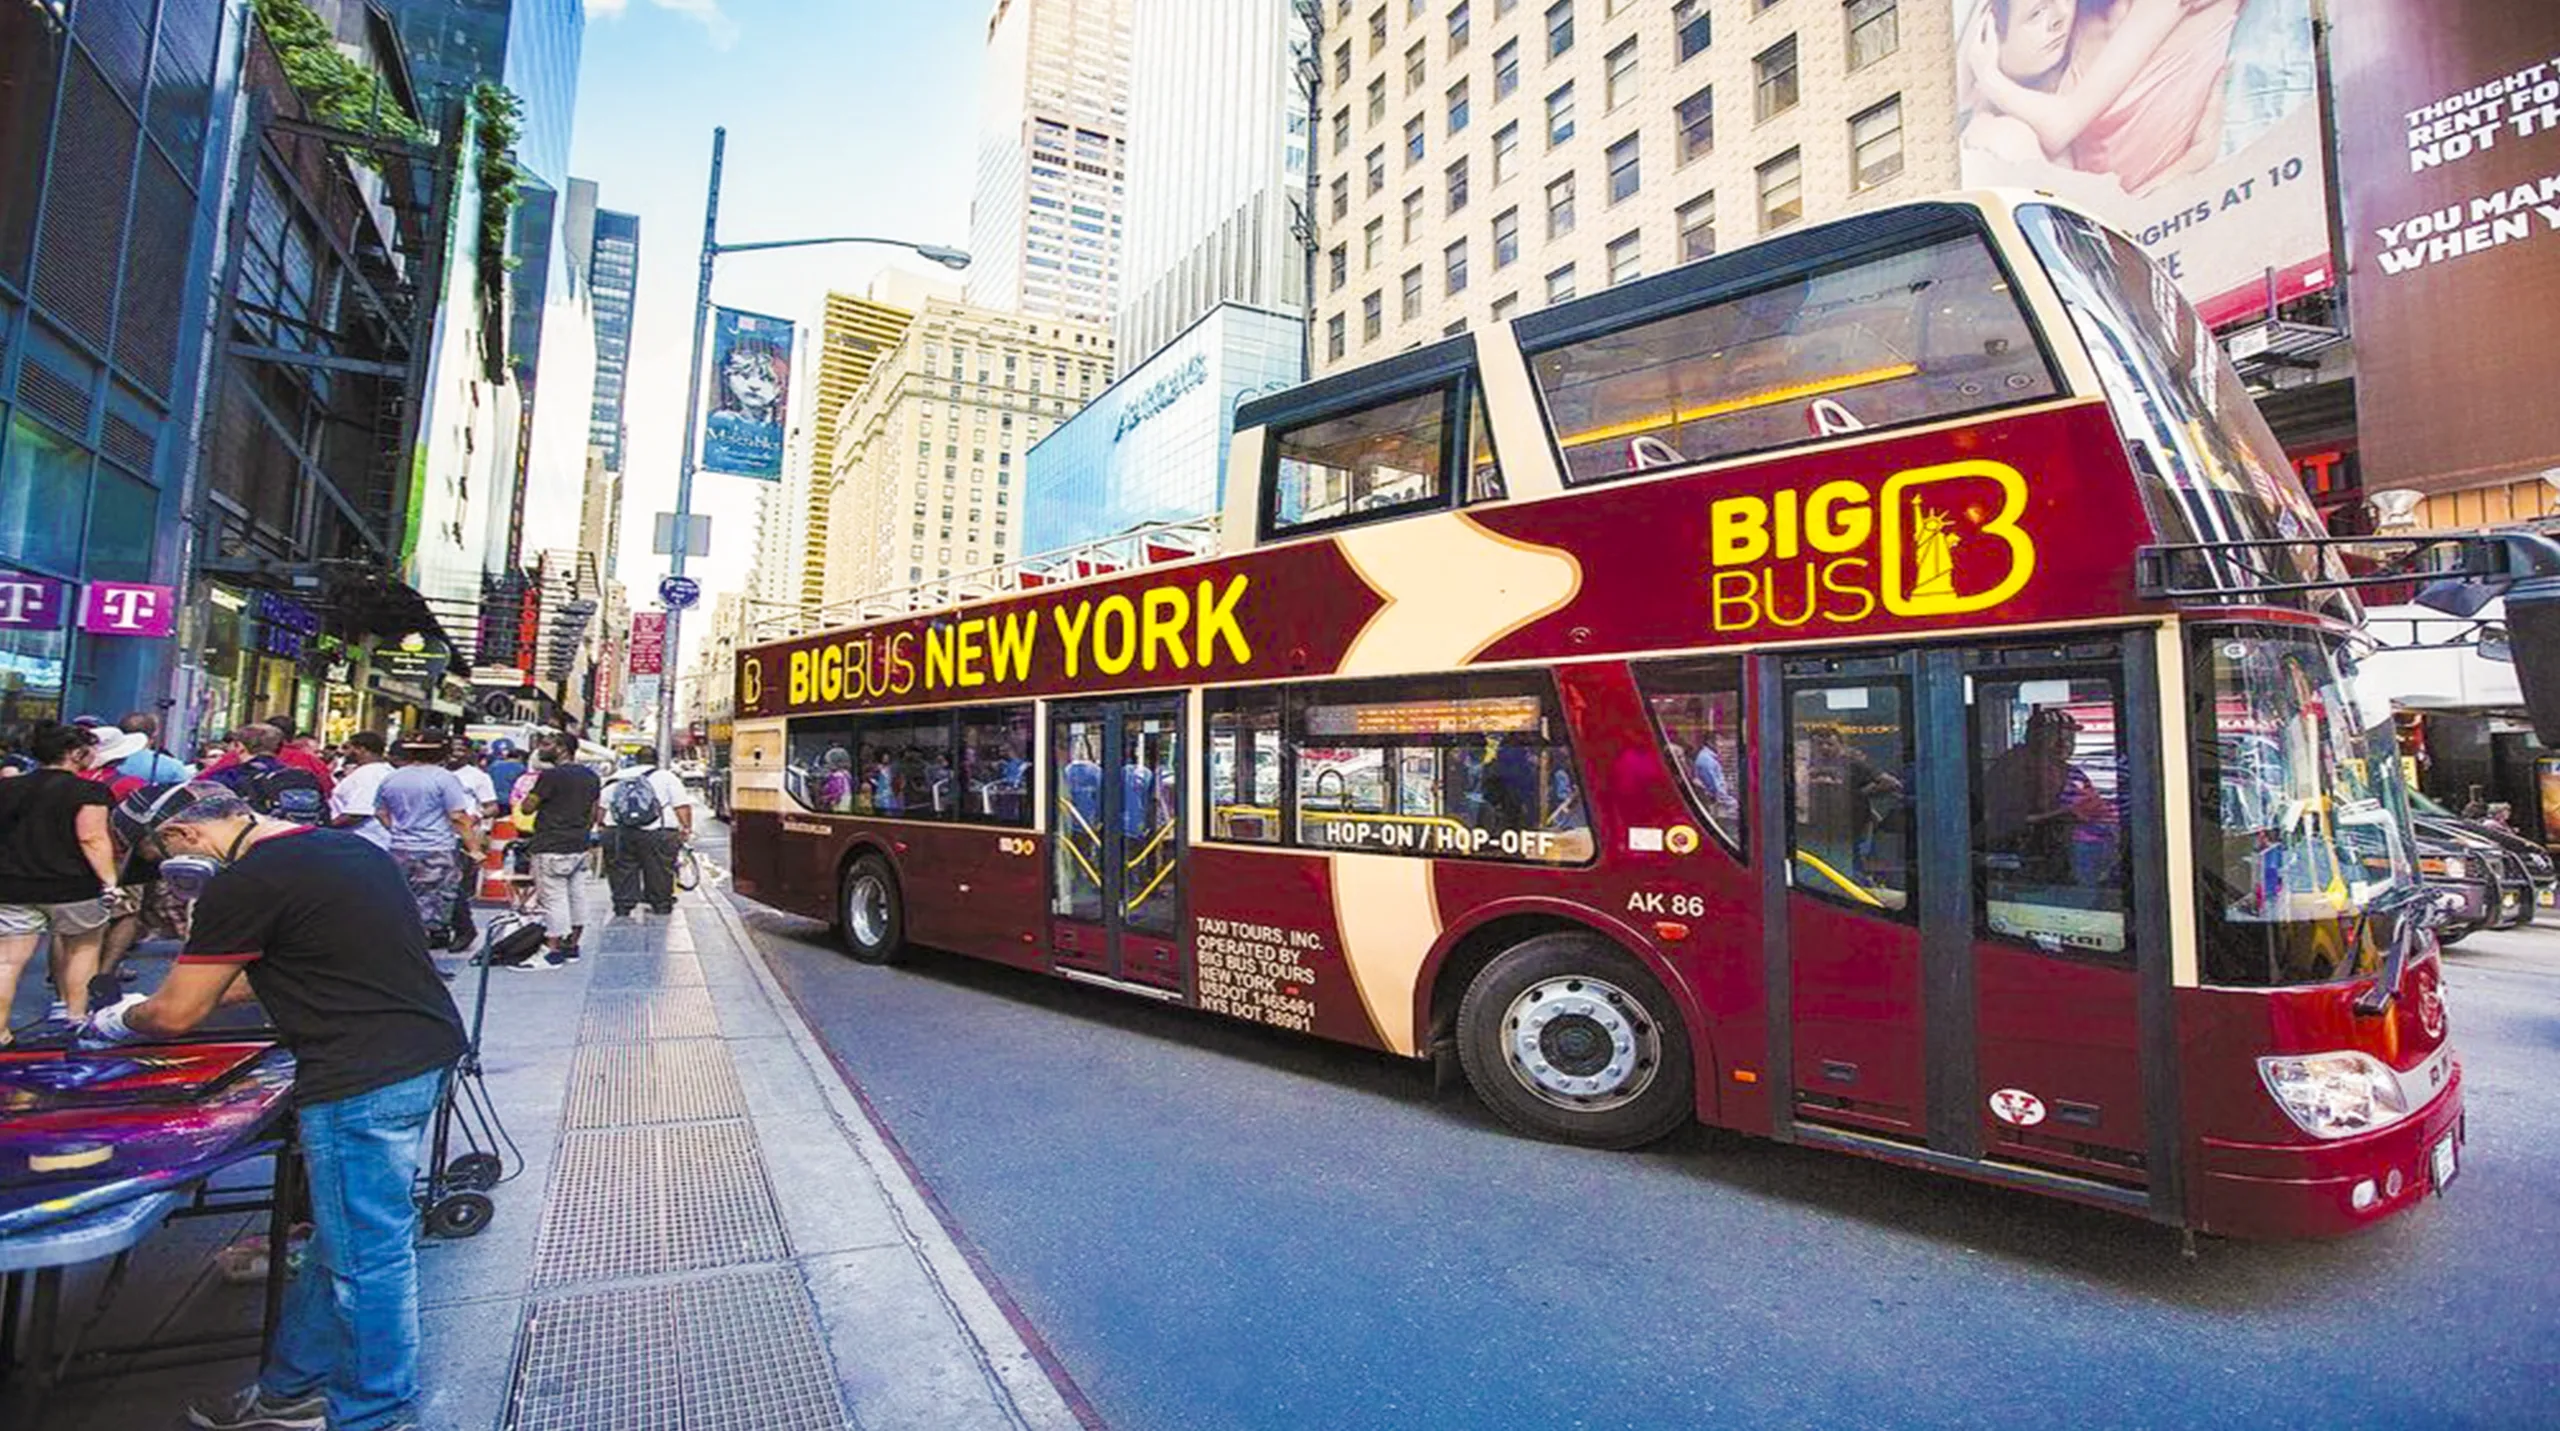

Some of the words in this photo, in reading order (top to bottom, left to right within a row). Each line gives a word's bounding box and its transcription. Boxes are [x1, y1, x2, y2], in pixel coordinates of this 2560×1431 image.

[2404, 63, 2547, 127] THOUGHT
[2408, 98, 2505, 149] RENT
[2410, 122, 2502, 173] NOT
[2220, 178, 2256, 211] AT
[2268, 157, 2304, 187] 10
[2375, 204, 2462, 248] YOU
[2376, 211, 2530, 276] WHEN
[1711, 480, 1872, 567] BIG
[103, 589, 156, 629] T
[1713, 557, 1876, 631] BUS
[925, 609, 1038, 690] NEW
[1054, 573, 1251, 678] YORK
[1326, 822, 1413, 848] HOP-ON
[1437, 827, 1555, 856] HOP-OFF
[1627, 891, 1666, 914] AK
[1671, 894, 1705, 917] 86
[1196, 917, 1228, 935] TAXI
[1290, 930, 1324, 951] INC.
[1196, 934, 1276, 962] OPERATED
[1279, 948, 1301, 965] BY
[1197, 949, 1223, 967] BIG
[1225, 954, 1257, 974] BUS
[1260, 961, 1316, 985] TOURS
[1198, 965, 1231, 983] NEW
[1233, 971, 1277, 993] YORK
[1199, 980, 1248, 1002] USDOT
[1200, 995, 1229, 1014] NYS
[1231, 1001, 1262, 1020] DOT
